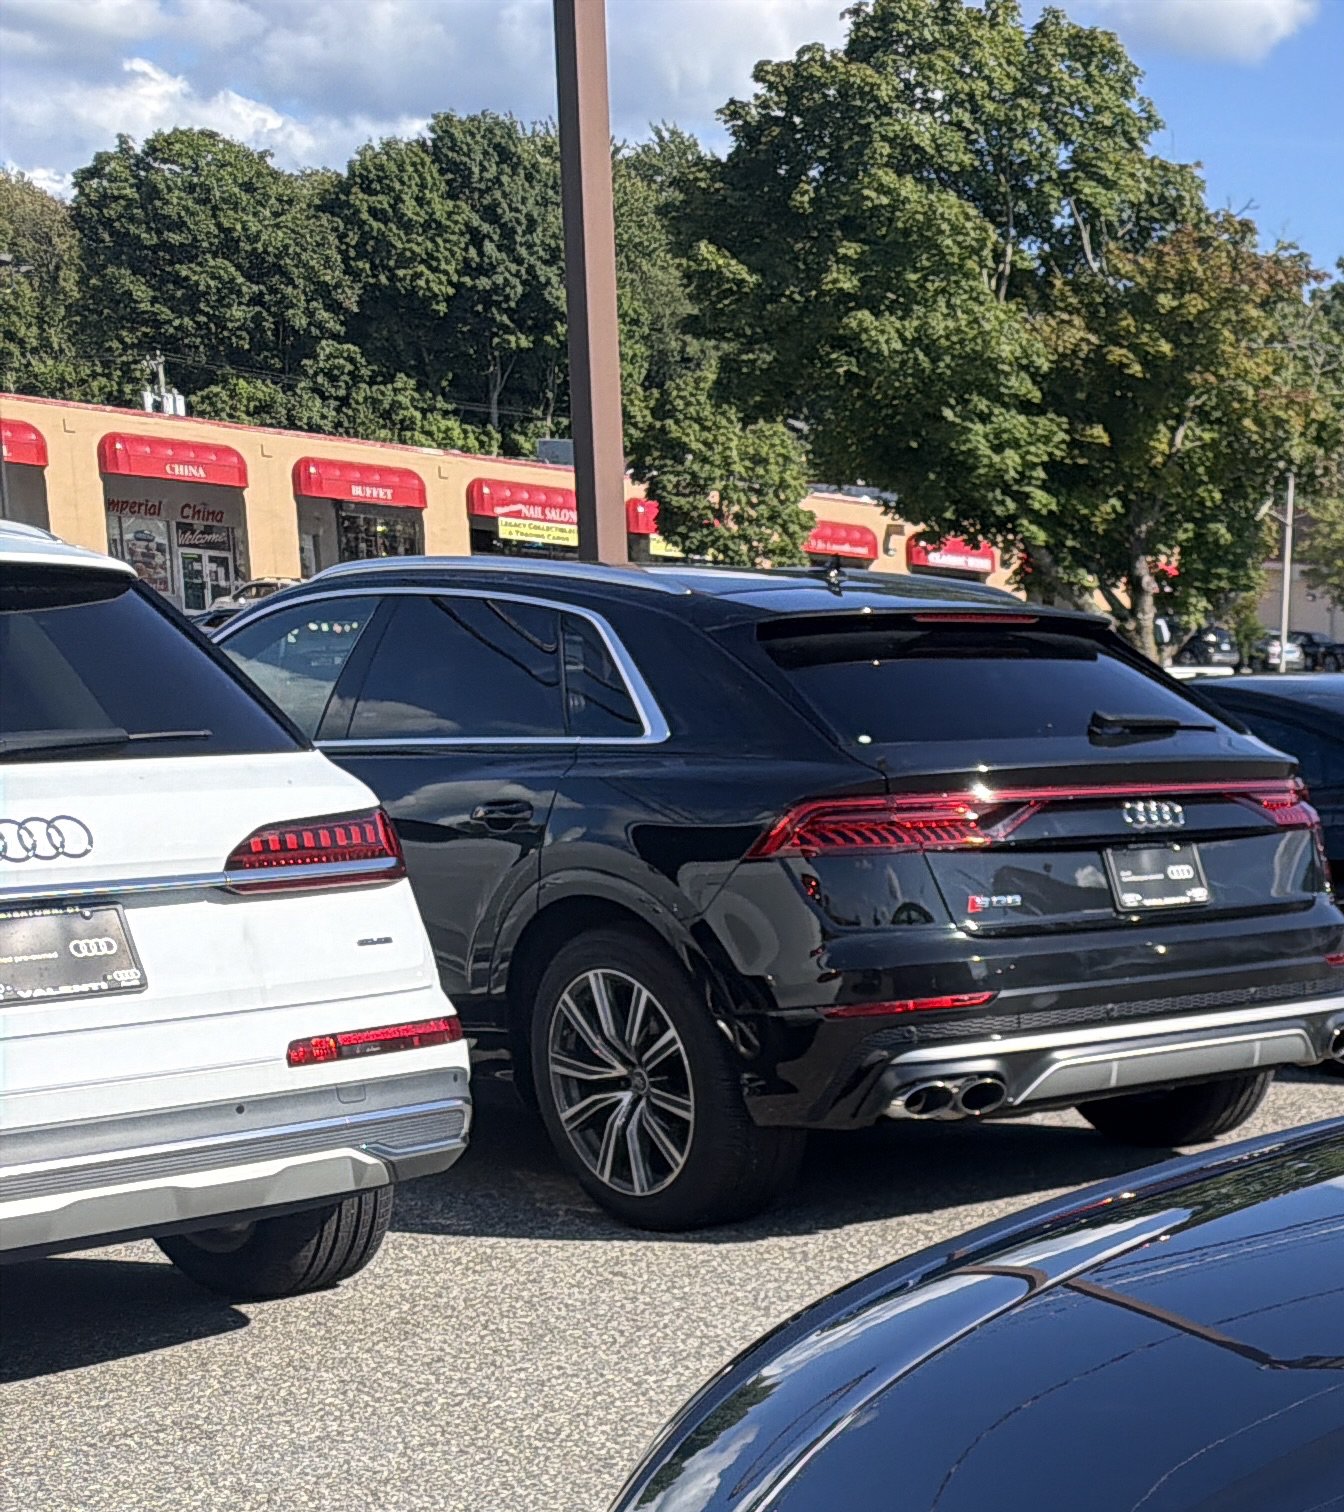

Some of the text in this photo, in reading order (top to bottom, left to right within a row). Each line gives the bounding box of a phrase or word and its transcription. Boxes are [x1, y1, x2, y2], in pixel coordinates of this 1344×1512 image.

[165, 463, 207, 478] CHINA
[351, 484, 393, 500] BUFFET
[108, 498, 225, 523] mperial China
[521, 504, 545, 519] NAIL
[178, 530, 228, 546] Welcome
